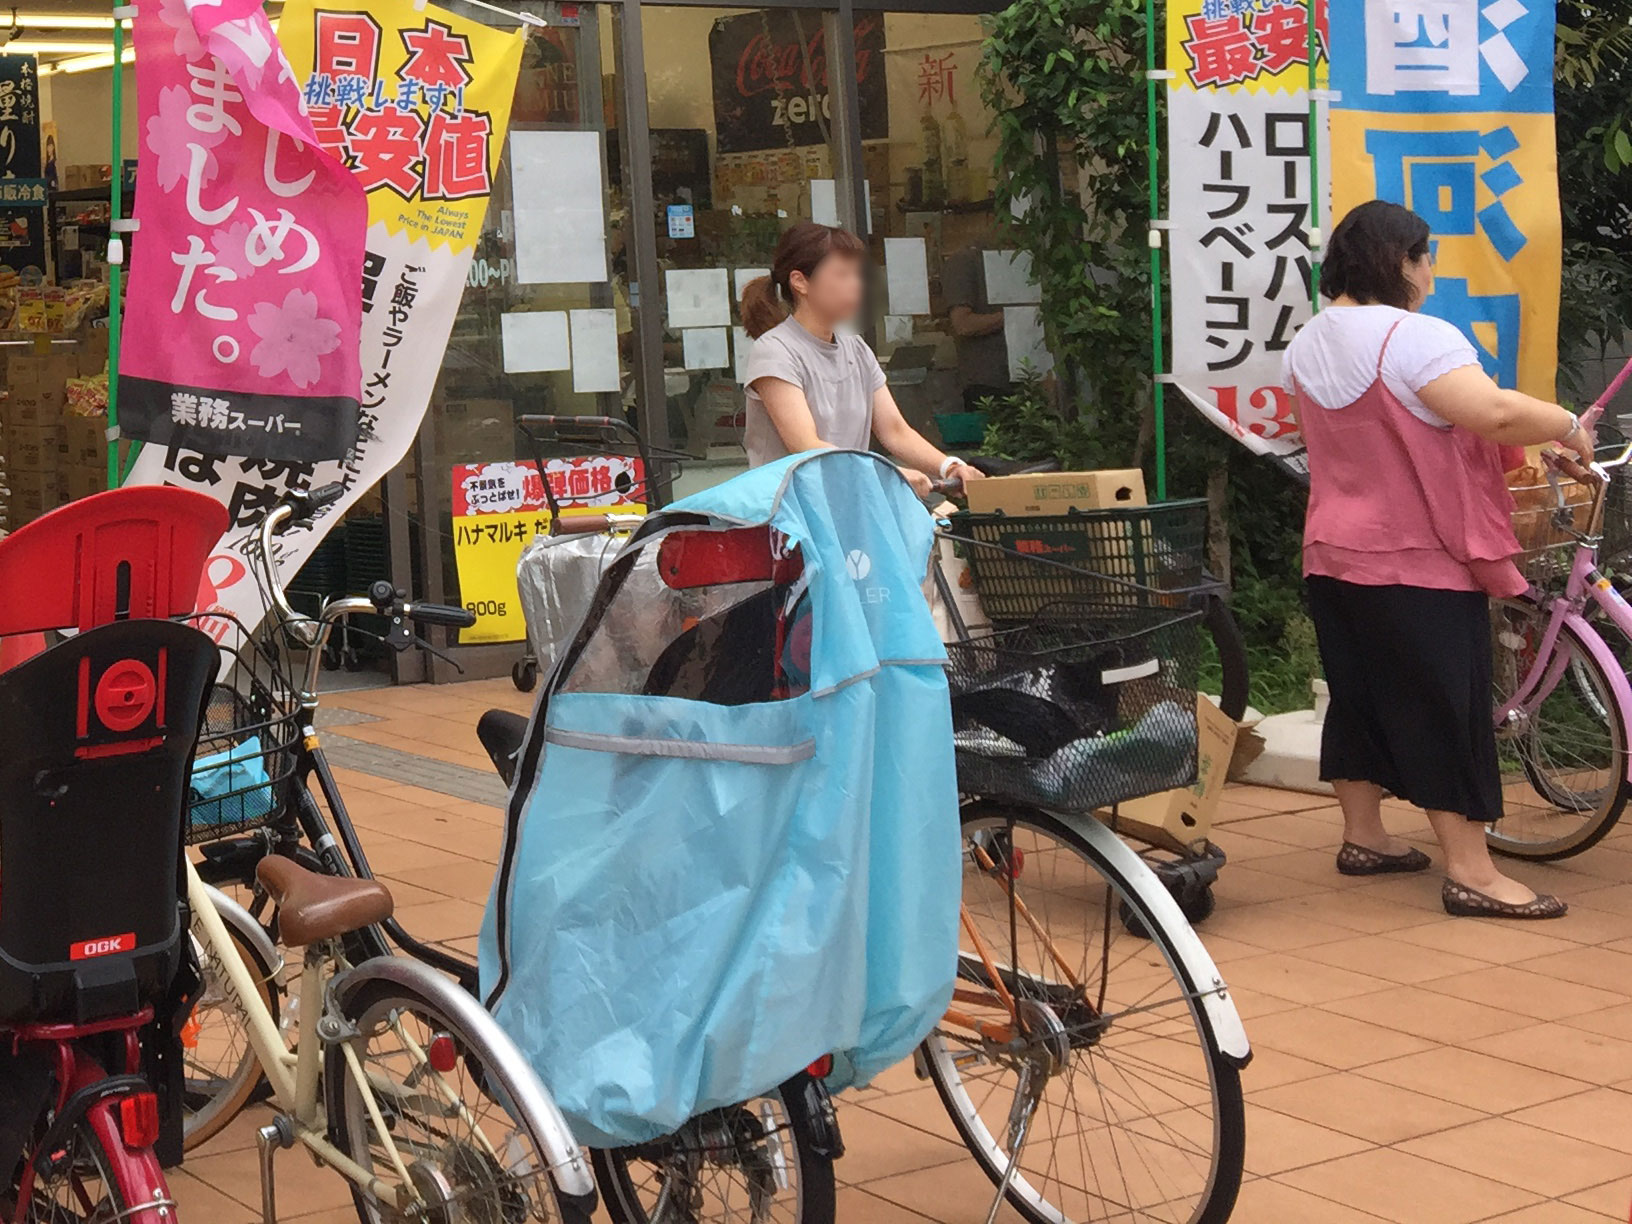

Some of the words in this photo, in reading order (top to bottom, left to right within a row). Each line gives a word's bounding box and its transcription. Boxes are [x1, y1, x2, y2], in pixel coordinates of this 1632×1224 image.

[312, 9, 473, 90] 日本
[917, 51, 959, 106] 新
[1199, 111, 1256, 372] ハーフベーコン
[170, 391, 302, 433] 業務スーパー
[456, 519, 529, 547] ハナマルキ
[83, 936, 122, 956] OGK
